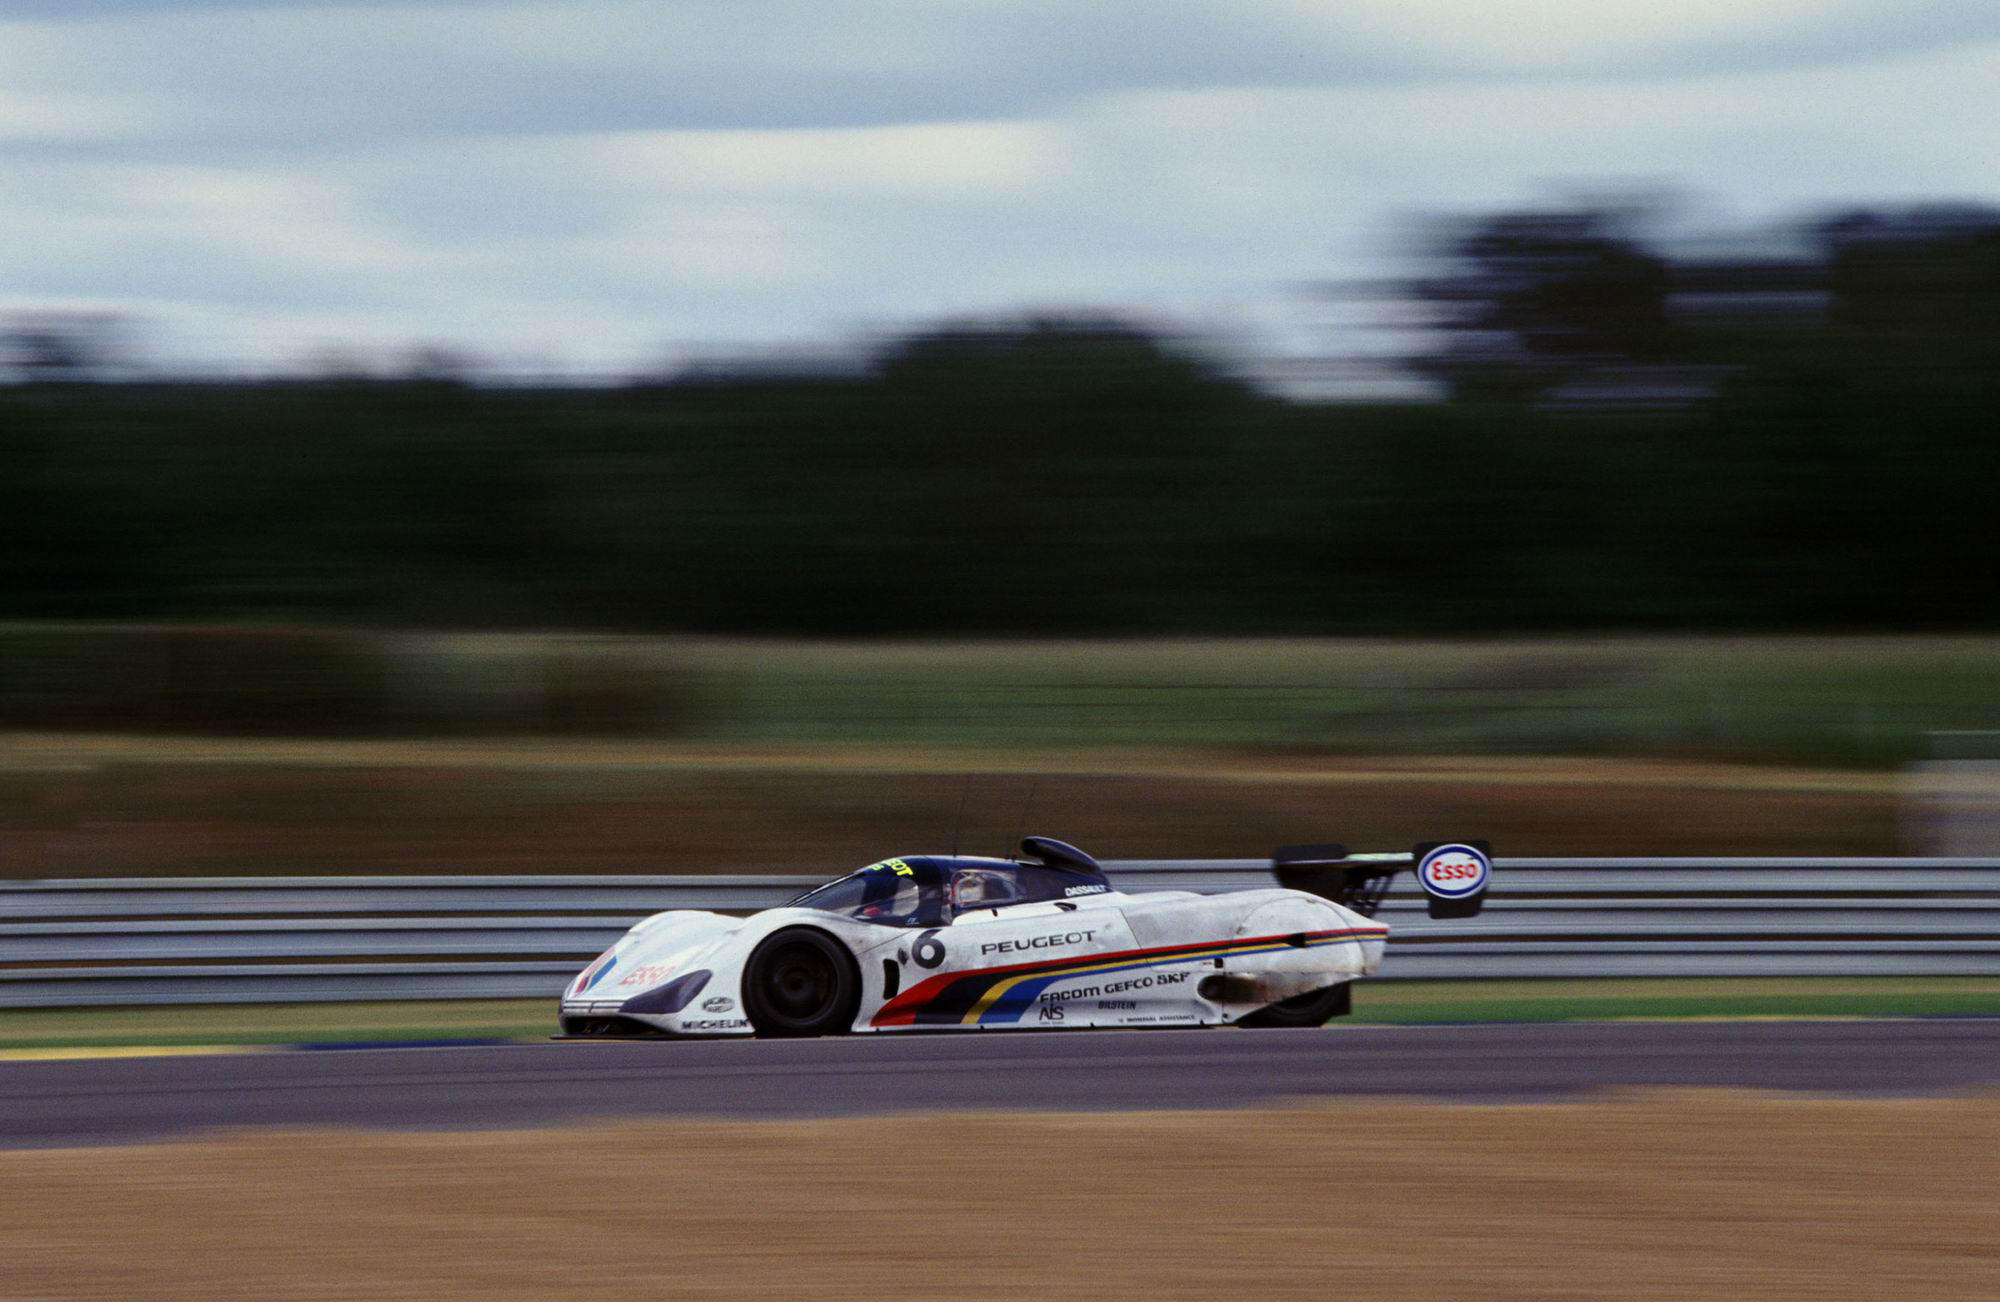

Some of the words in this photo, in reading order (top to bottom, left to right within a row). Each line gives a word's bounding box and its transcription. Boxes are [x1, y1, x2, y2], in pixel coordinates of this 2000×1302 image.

[1432, 861, 1478, 881] Esso
[911, 928, 946, 970] 6
[980, 930, 1097, 956] PEUGEOT
[1039, 986, 1100, 1003] FACOM
[1104, 977, 1153, 994] GEFCO
[1157, 972, 1191, 985] SKF
[1097, 1000, 1137, 1010] BILSTEIN
[681, 1019, 749, 1030] MICHELIN
